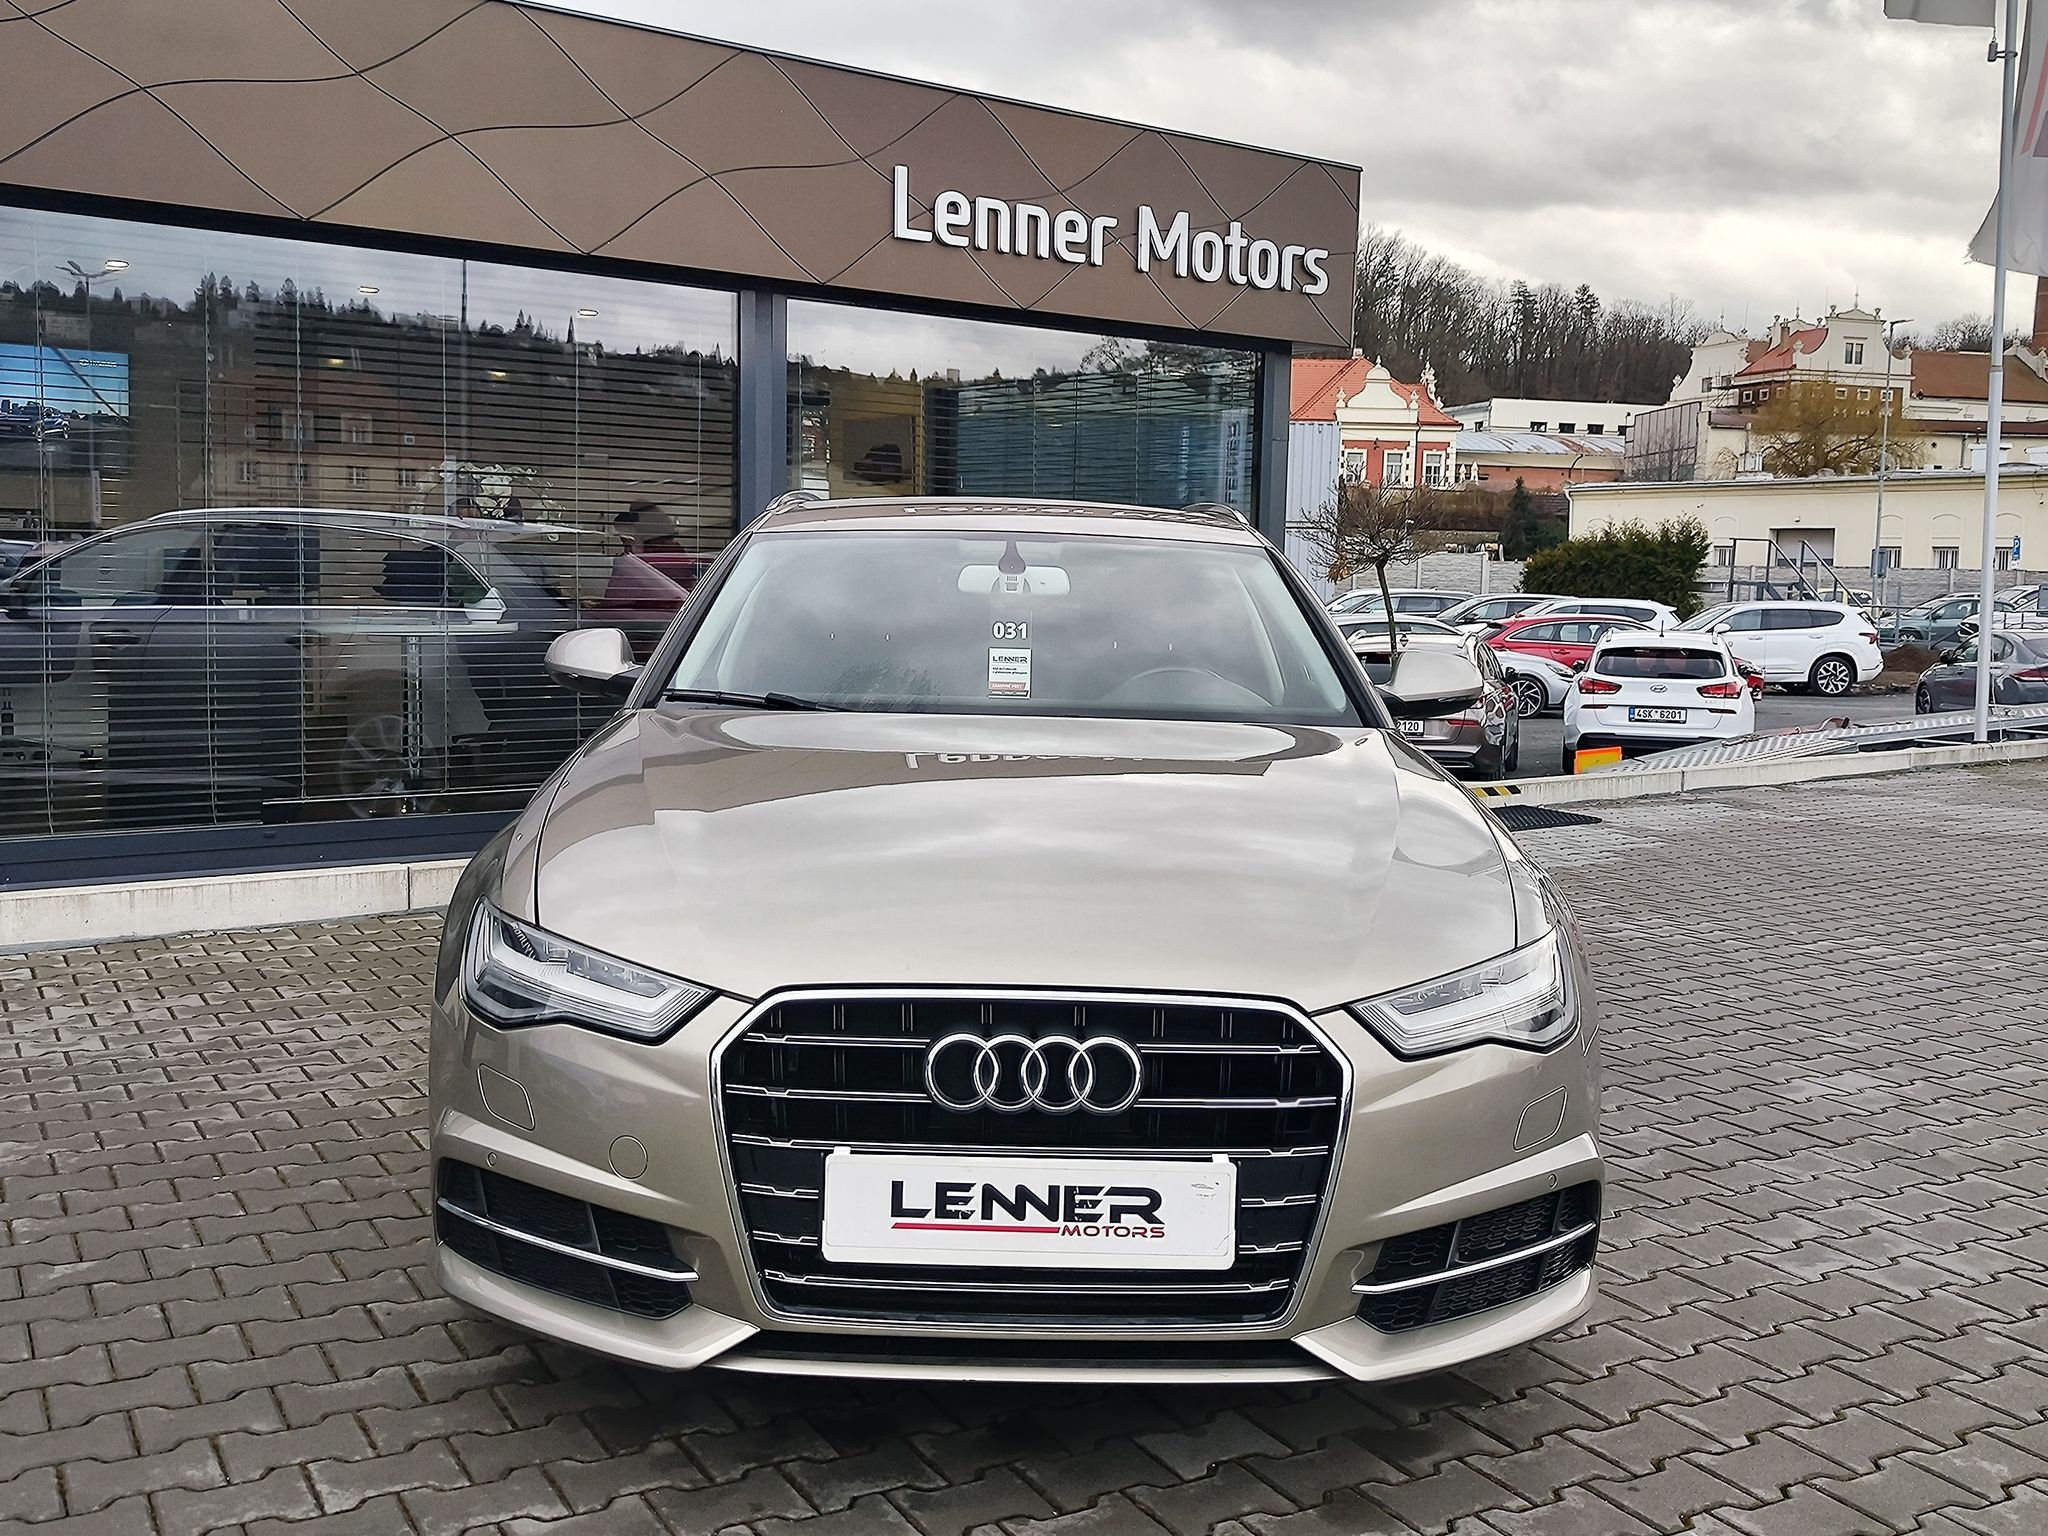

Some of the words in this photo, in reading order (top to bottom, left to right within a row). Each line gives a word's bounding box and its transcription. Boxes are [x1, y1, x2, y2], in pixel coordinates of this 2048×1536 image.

[893, 165, 1118, 267] Lenner
[1137, 205, 1329, 295] Motors
[992, 621, 1028, 639] 031
[992, 656, 1027, 664] LENNER
[1637, 709, 1654, 719] 4SK
[1659, 710, 1682, 720] 6201
[1396, 721, 1419, 732] 2120
[891, 1180, 1164, 1224] LENNER
[1061, 1224, 1166, 1239] MOTORS
